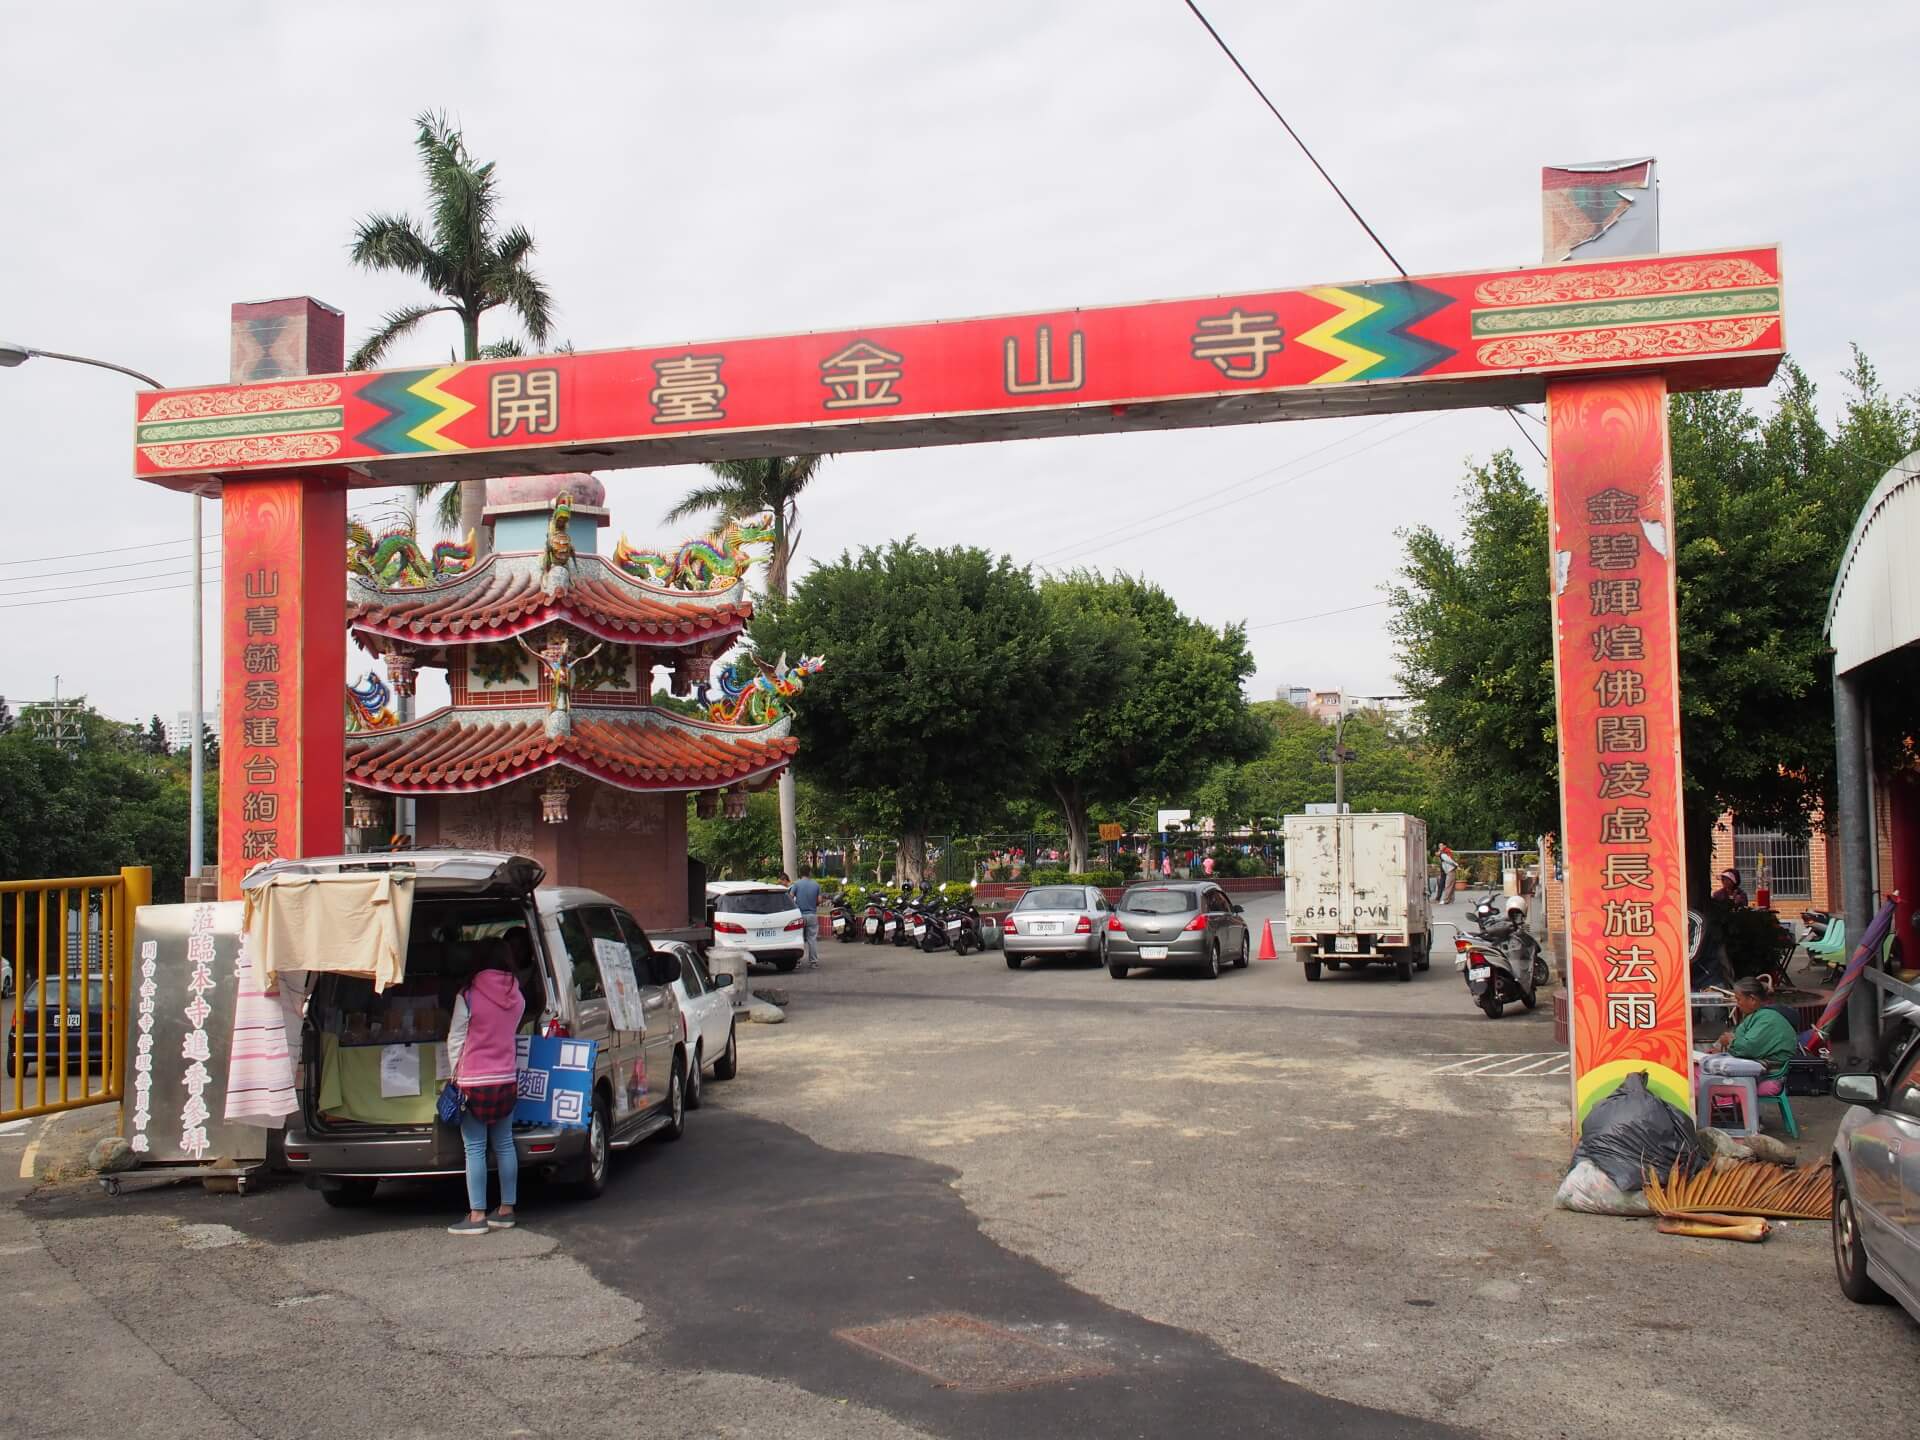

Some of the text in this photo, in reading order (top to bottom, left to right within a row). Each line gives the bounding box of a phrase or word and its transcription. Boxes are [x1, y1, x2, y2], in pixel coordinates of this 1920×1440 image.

[489, 310, 1284, 438] 開臺金山寺
[243, 569, 280, 875] 山青毓秀蓮台絢綵
